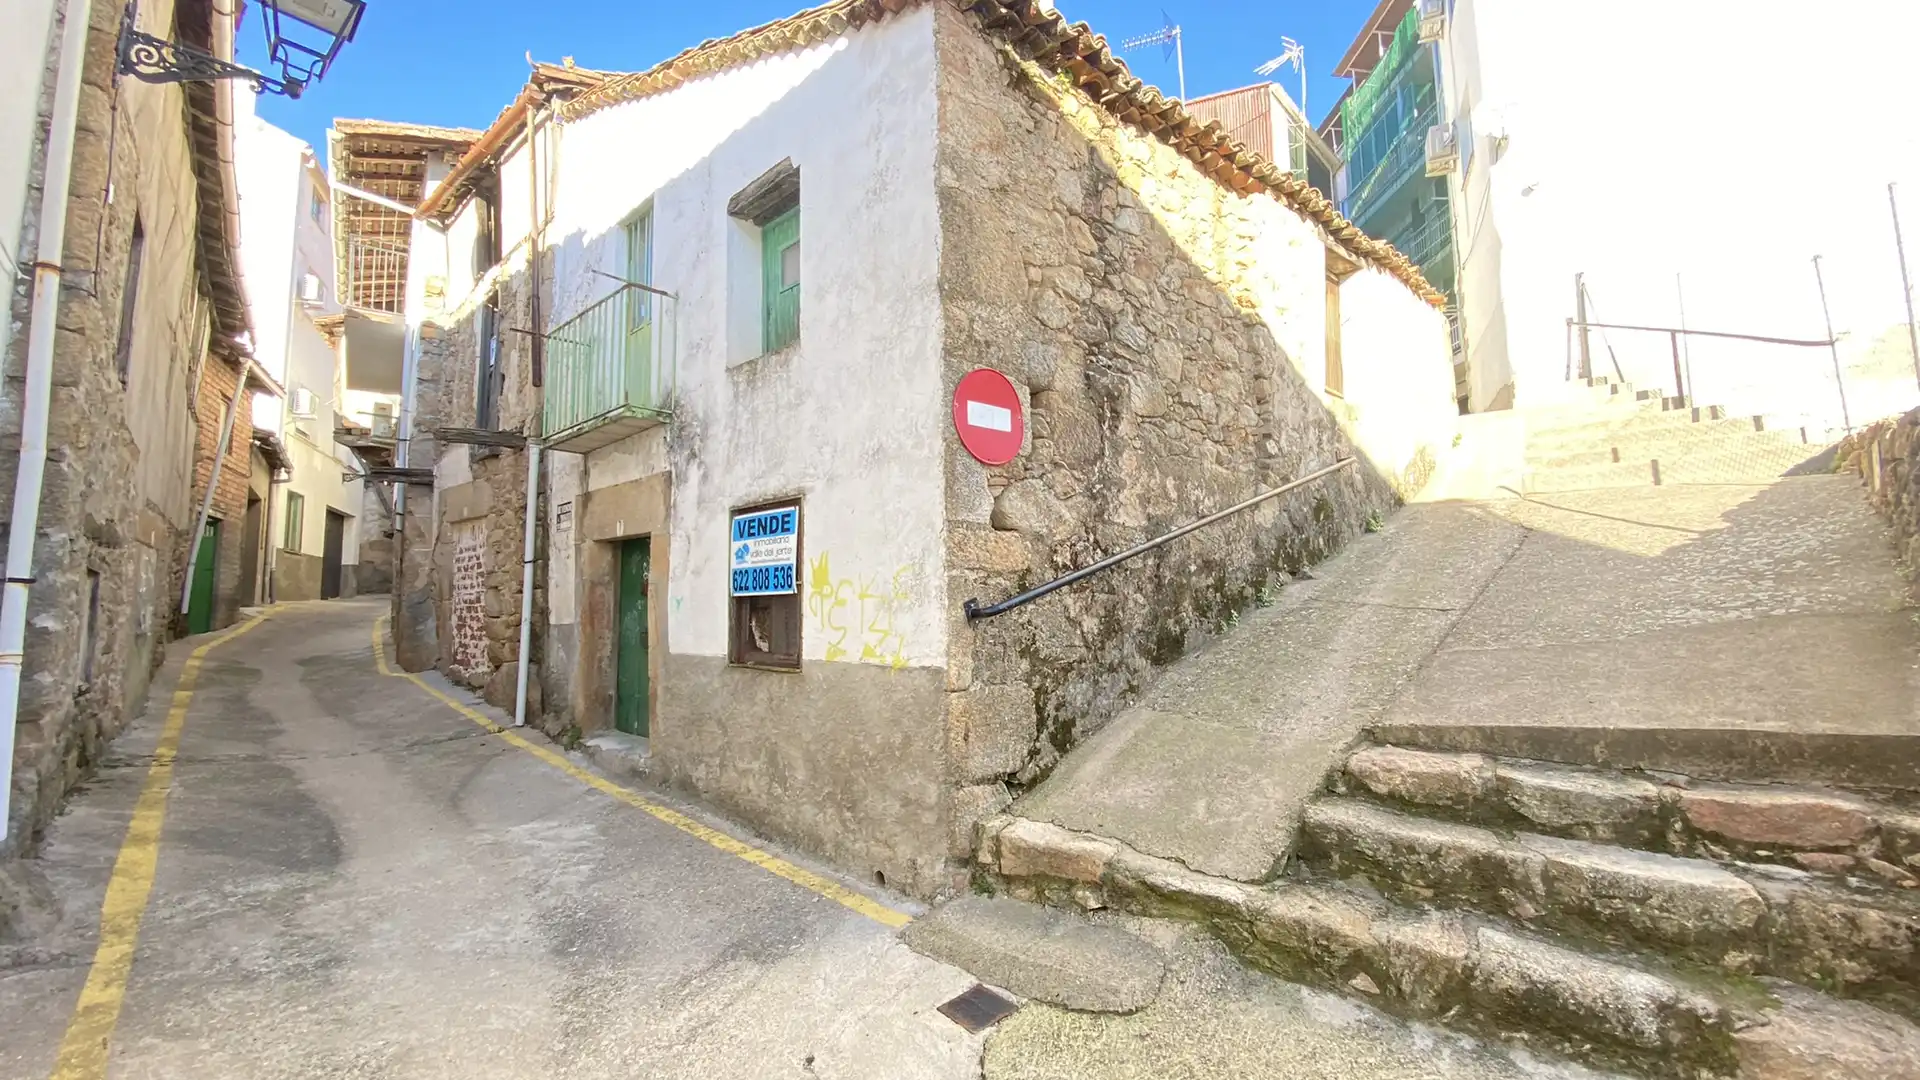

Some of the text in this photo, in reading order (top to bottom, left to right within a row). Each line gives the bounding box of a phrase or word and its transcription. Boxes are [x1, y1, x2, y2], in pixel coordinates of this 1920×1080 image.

[738, 514, 791, 538] VENDE
[733, 565, 793, 591] 622 808 536
